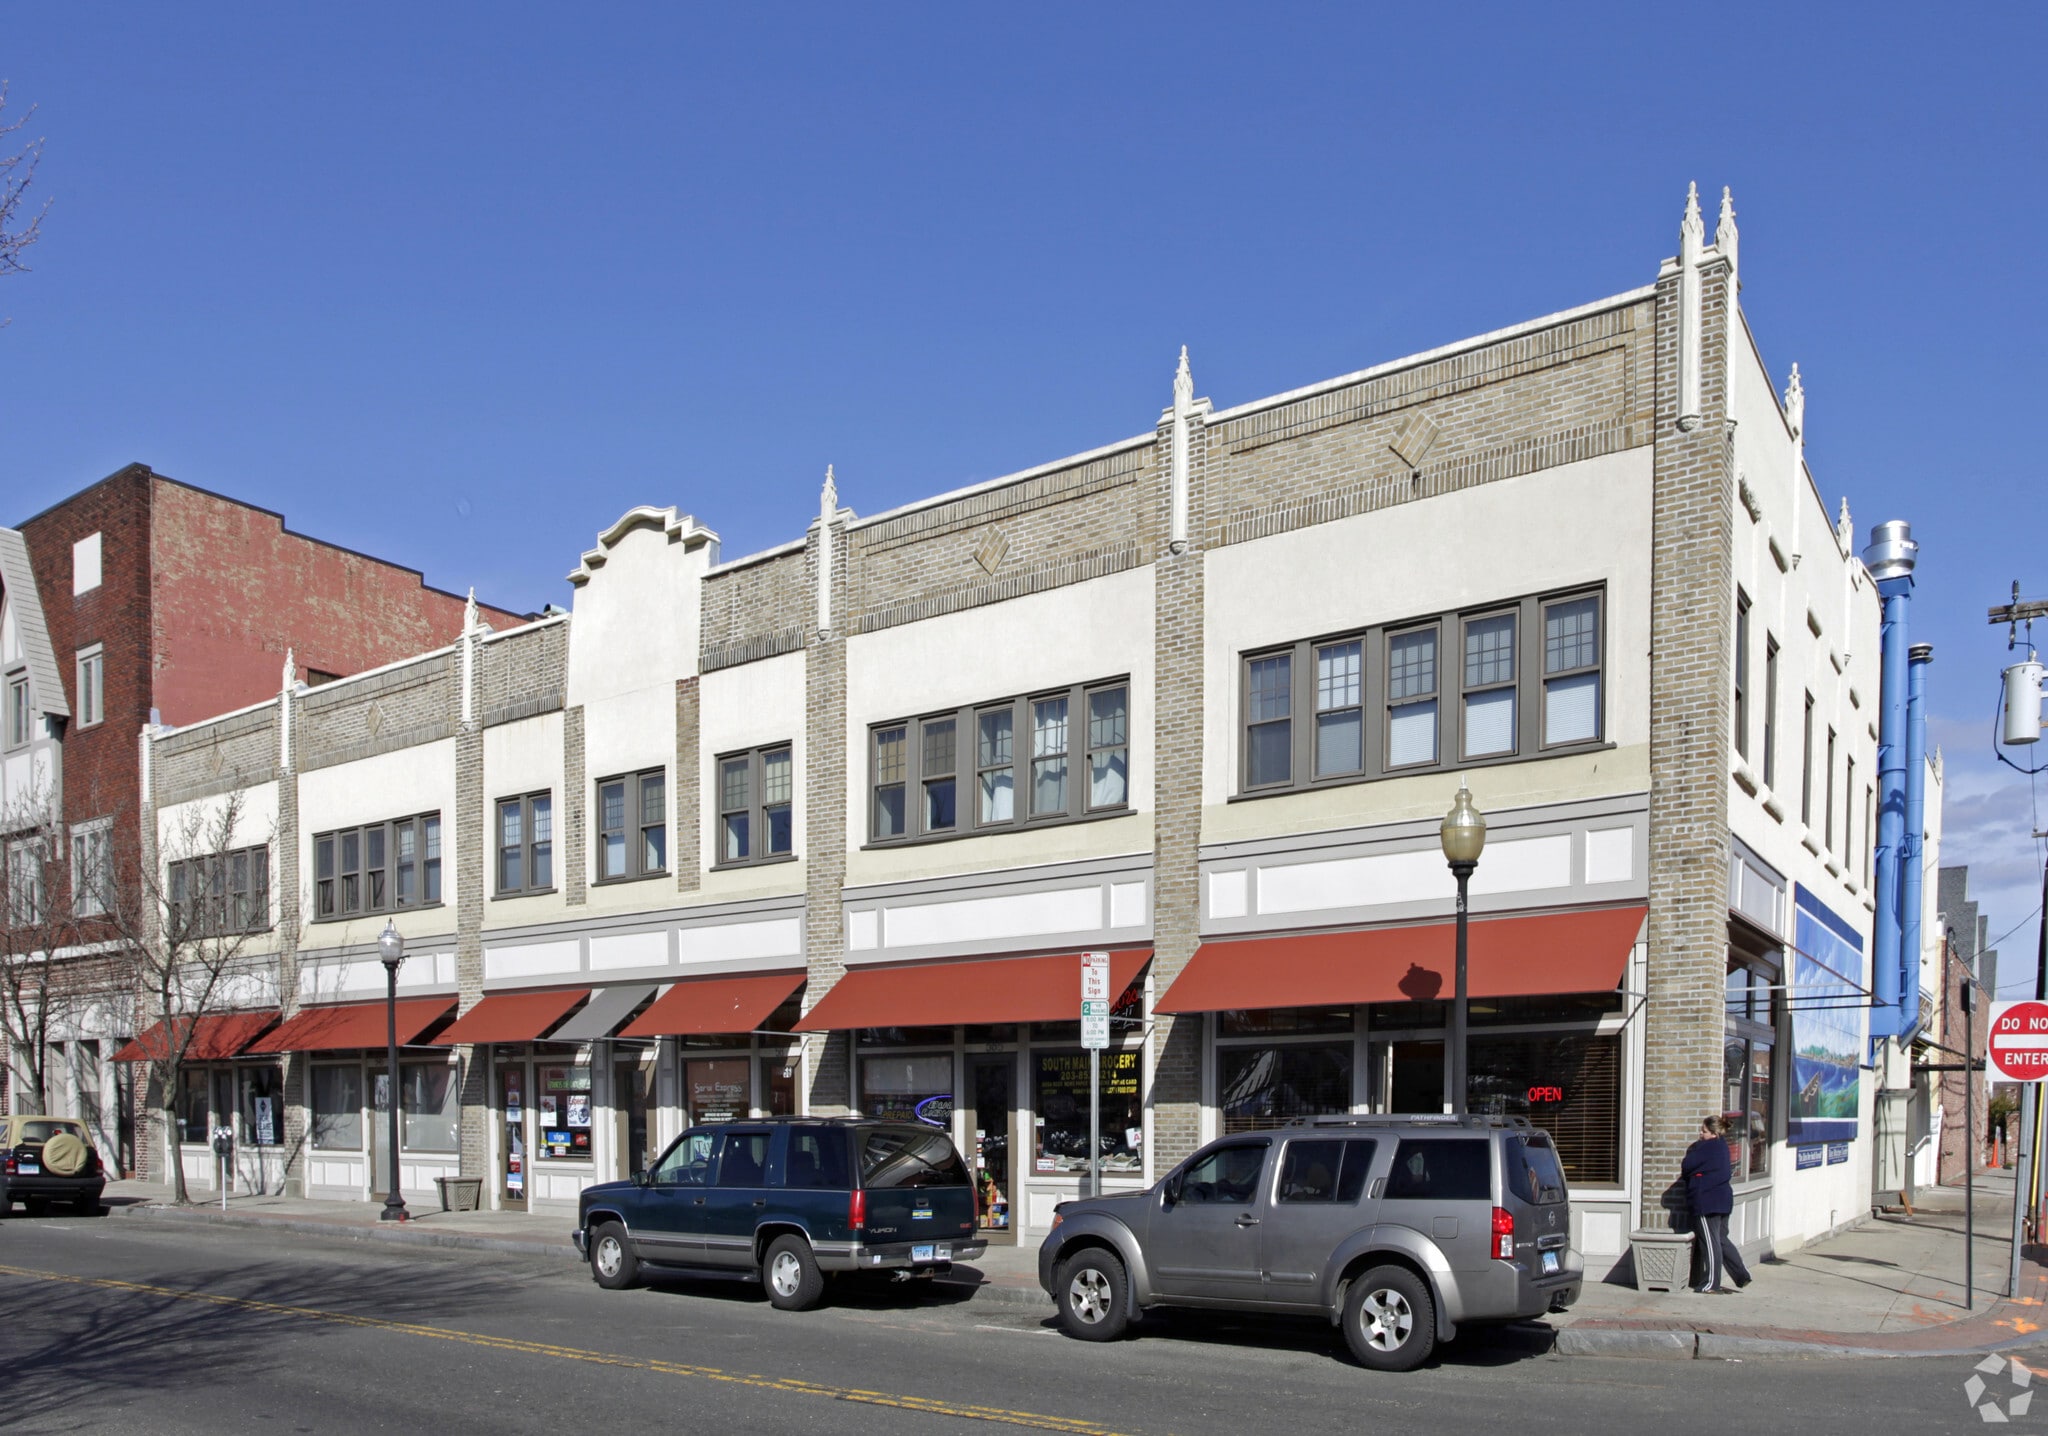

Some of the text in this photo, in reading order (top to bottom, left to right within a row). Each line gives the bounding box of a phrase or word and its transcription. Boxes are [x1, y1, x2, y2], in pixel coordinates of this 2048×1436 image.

[1088, 988, 1101, 996] Sign
[1083, 1004, 1090, 1014] 2
[2001, 1017, 2048, 1030] DO NO
[1042, 1057, 1071, 1071] SOUTH
[1100, 1054, 1137, 1069] ROCERY
[2004, 1052, 2048, 1065] ENTER
[714, 1081, 742, 1095] Express
[1528, 1086, 1562, 1102] OPEN
